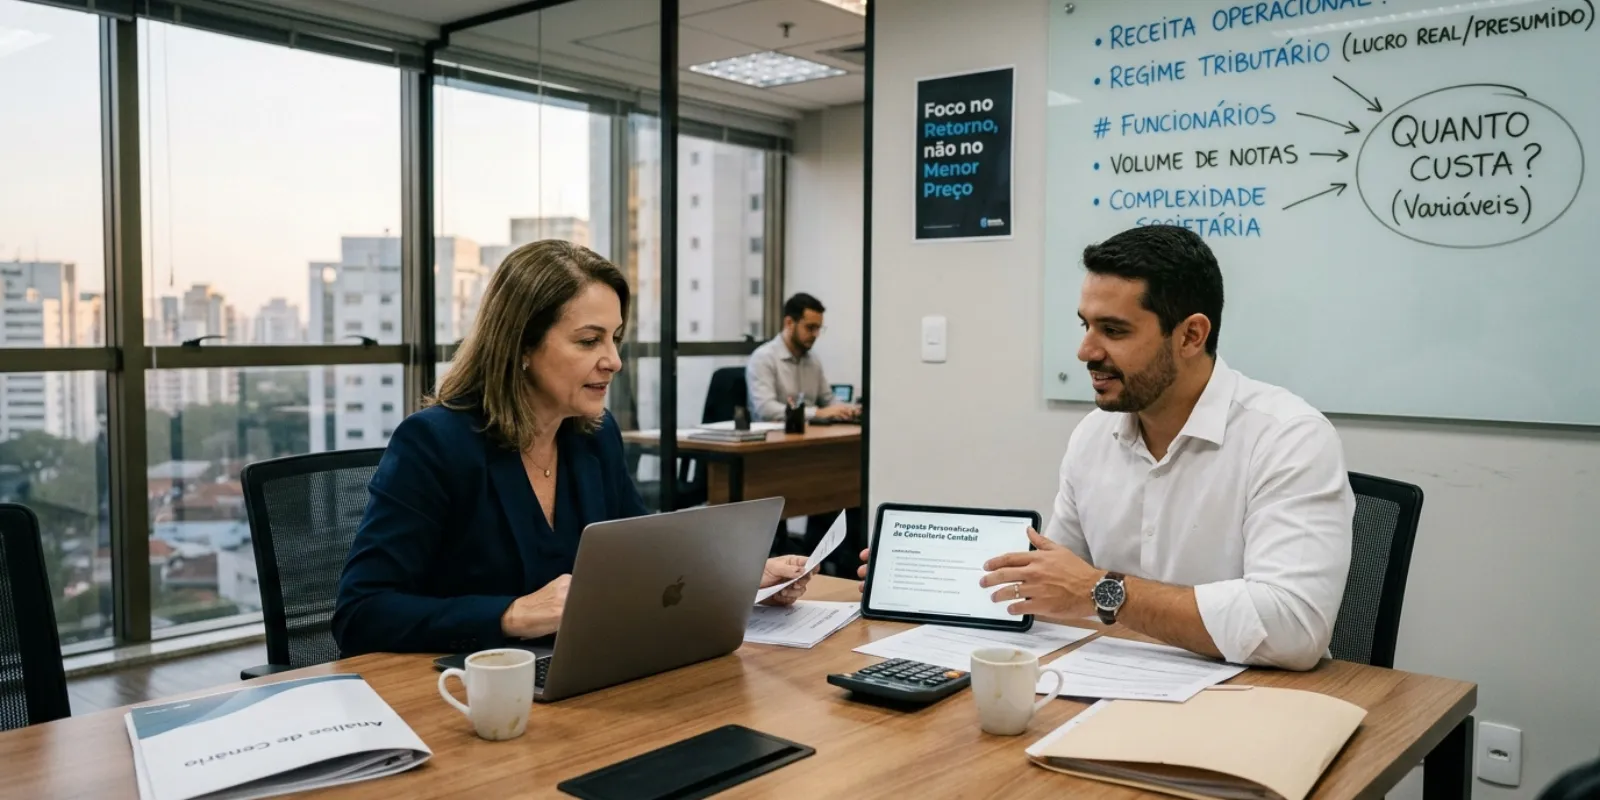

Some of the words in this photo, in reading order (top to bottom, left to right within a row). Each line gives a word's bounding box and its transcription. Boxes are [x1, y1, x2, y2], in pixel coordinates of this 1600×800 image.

[1109, 16, 1196, 49] RECEITA
[1109, 60, 1186, 89] REGIME
[1198, 38, 1330, 77] TRIBUTÁRIO
[1342, 32, 1407, 62] (LUCRO
[1417, 0, 1595, 46] REAL/PRESUMIDO)
[924, 101, 966, 118] Foco
[970, 98, 994, 113] no
[1094, 116, 1111, 139] #
[1121, 99, 1276, 136] FUNCIONÁRIOS
[924, 119, 999, 138] Retorno,
[1391, 111, 1530, 148] QUANTO
[923, 140, 957, 158] não
[960, 140, 983, 155] no
[1110, 152, 1183, 174] VOLUME
[1195, 150, 1219, 168] DE
[1229, 144, 1299, 166] NOTAS
[923, 161, 979, 178] Menor
[1410, 151, 1513, 182] CUSTA
[923, 182, 973, 200] Preço
[1109, 185, 1266, 210] COMPLEXIDADE
[1391, 185, 1532, 226] (Variáveis)
[276, 733, 303, 744] de
